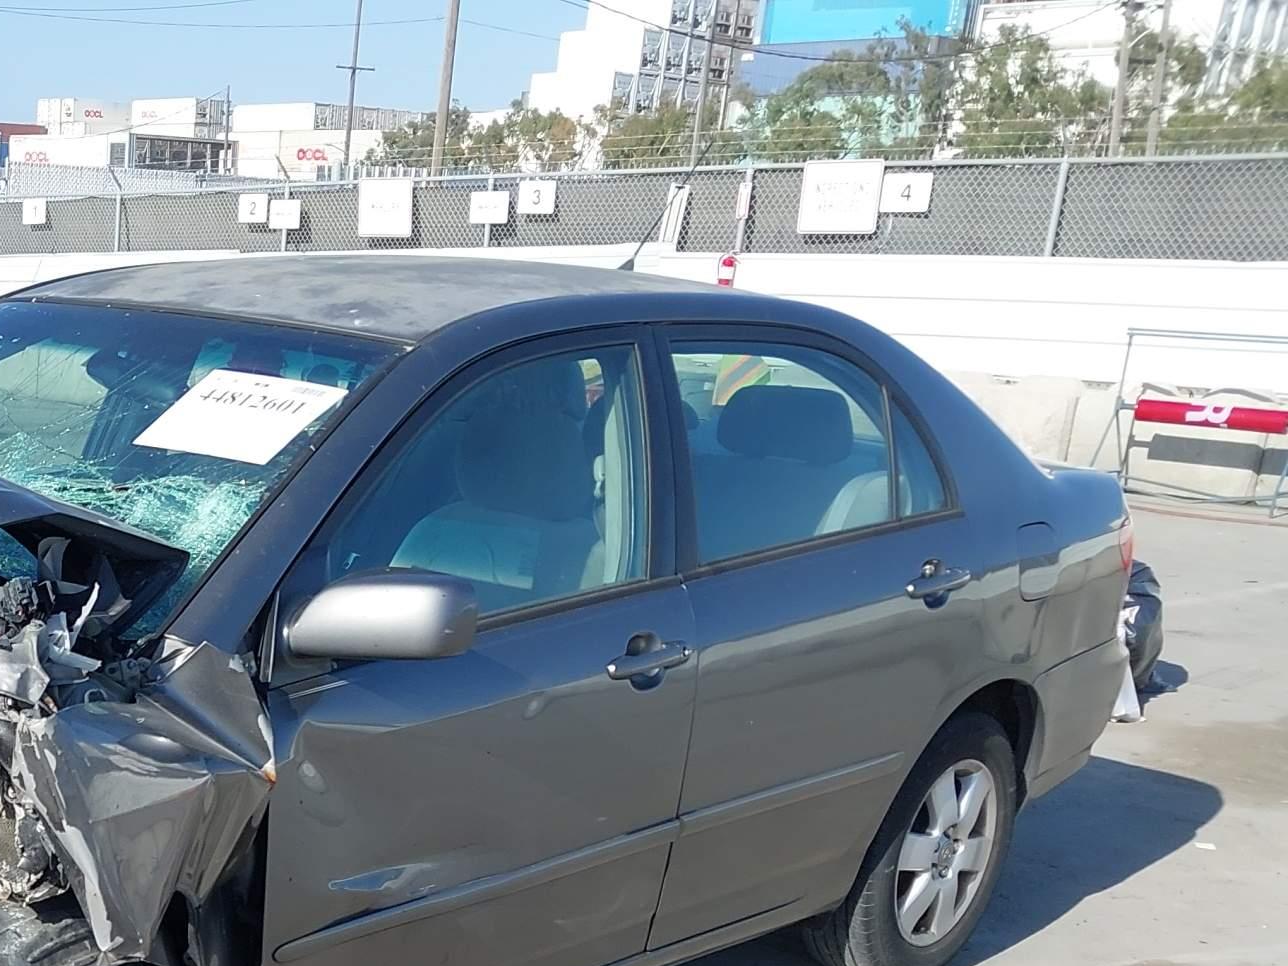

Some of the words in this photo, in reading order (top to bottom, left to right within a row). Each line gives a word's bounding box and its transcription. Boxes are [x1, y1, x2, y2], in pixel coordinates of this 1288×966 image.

[84, 109, 104, 119] OOCL
[296, 147, 329, 161] OOCL
[532, 189, 542, 206] 3
[900, 183, 913, 201] 4
[249, 201, 257, 215] 2
[200, 389, 306, 414] 44812601
